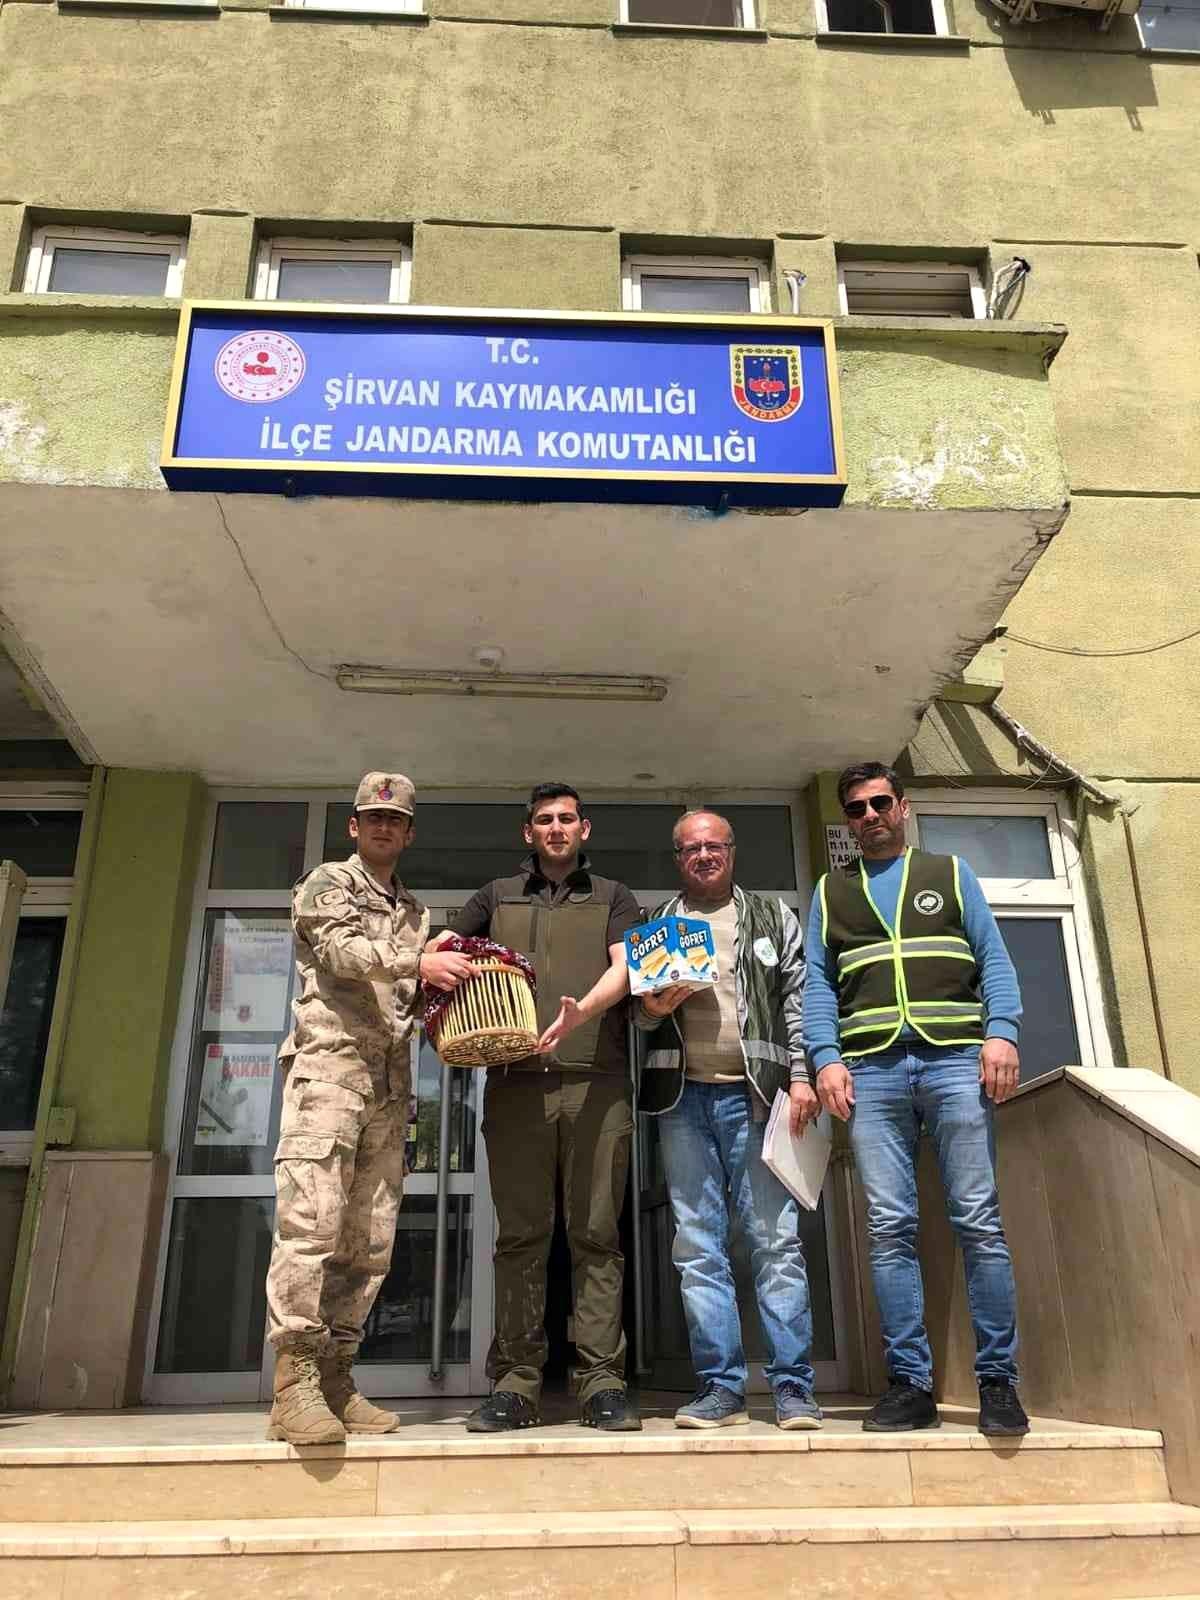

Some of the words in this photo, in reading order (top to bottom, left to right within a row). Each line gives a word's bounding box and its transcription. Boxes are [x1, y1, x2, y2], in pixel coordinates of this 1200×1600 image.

[484, 336, 540, 365] T.C.
[324, 373, 440, 411] ŞİRVAN
[454, 380, 697, 415] KAYMAKAMLIĞI
[259, 416, 334, 458] İLÇE
[345, 424, 524, 456] JANDARMA
[537, 428, 756, 463] KOMUTANLIĞI
[631, 926, 668, 961] GOFRET
[679, 930, 708, 948] GOFRET
